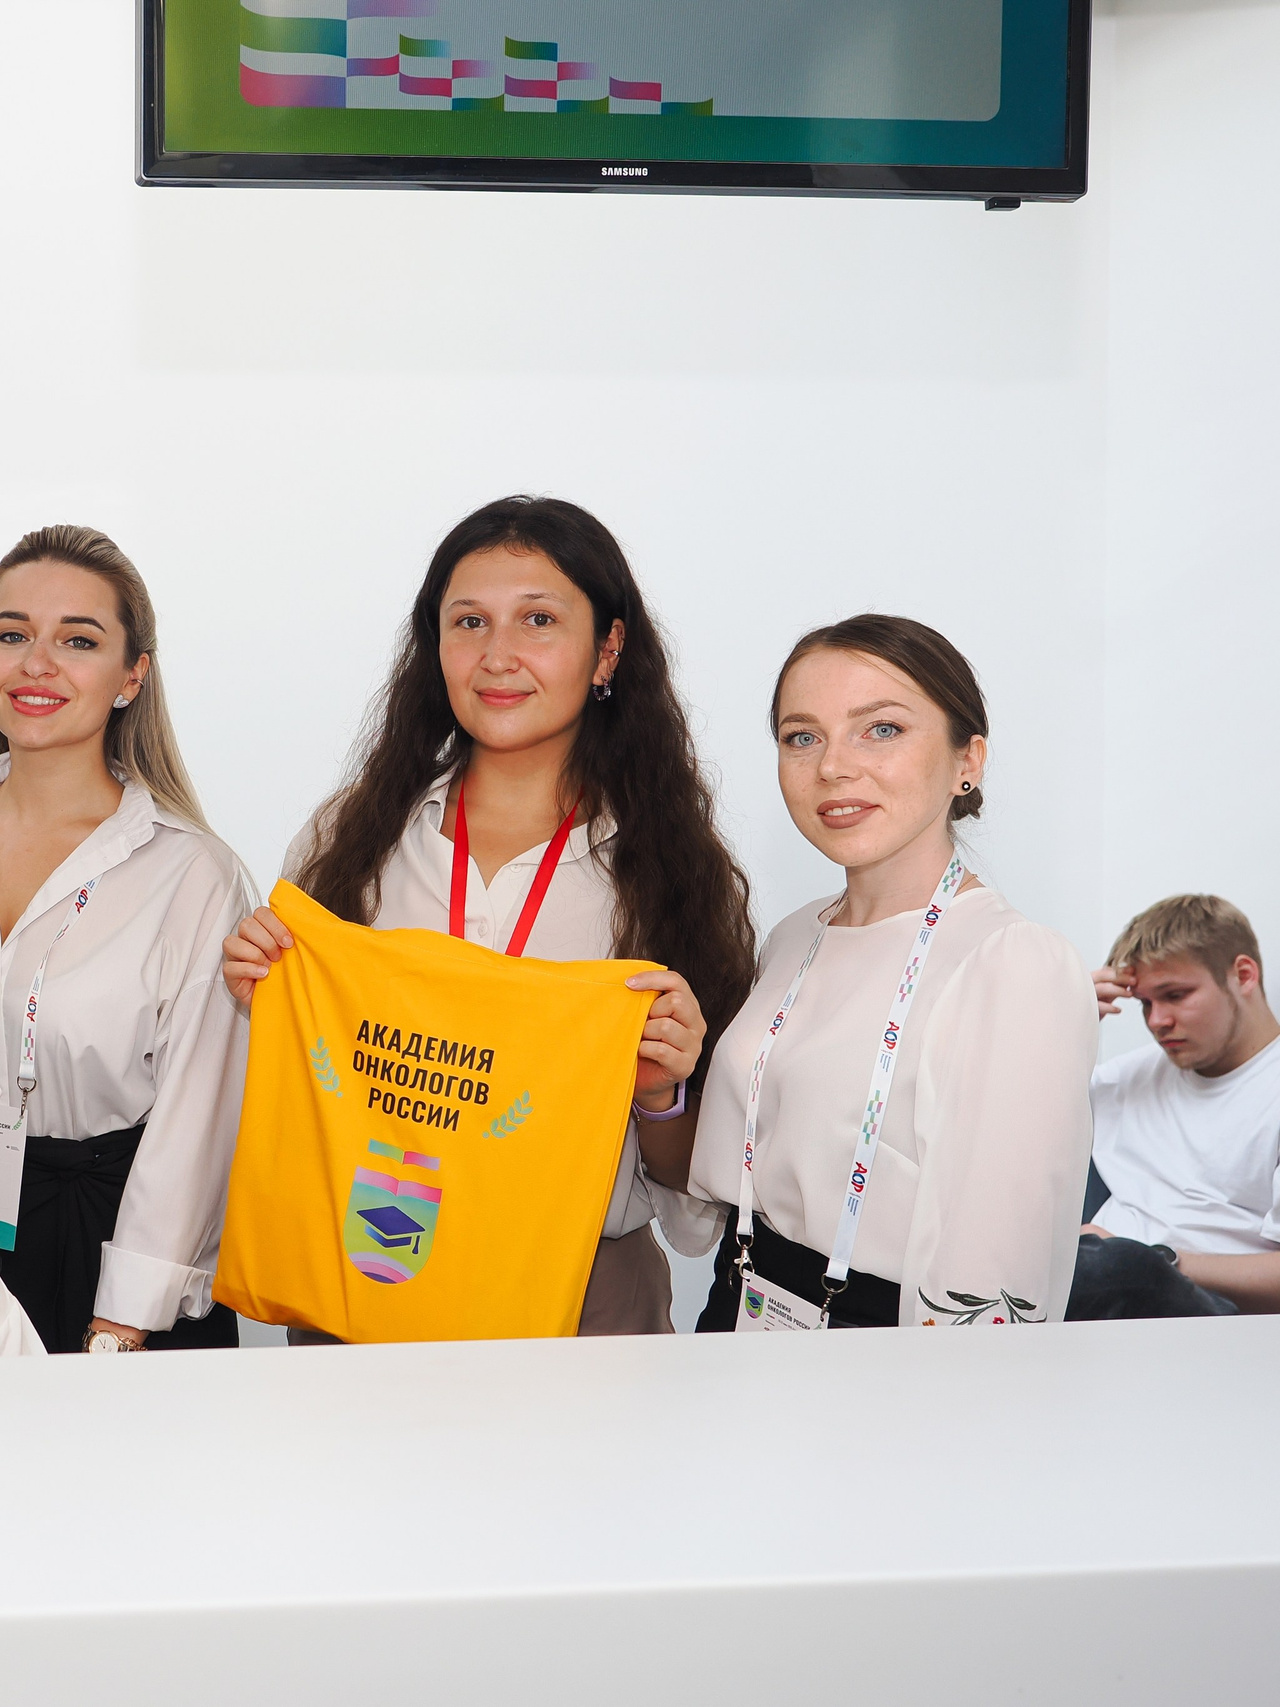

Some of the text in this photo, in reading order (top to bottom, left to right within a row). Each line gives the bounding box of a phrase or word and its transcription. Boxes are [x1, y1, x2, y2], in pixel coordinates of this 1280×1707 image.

[601, 167, 649, 176] SAMSUNG
[356, 1019, 495, 1074] АКАДЕМИЯ
[352, 1049, 490, 1106] ОНКОЛОГОВ
[367, 1087, 460, 1132] РОССИИ
[767, 1303, 793, 1322] ОНКОЛОГОВ
[768, 1296, 792, 1313] АКАДЕМИЯ
